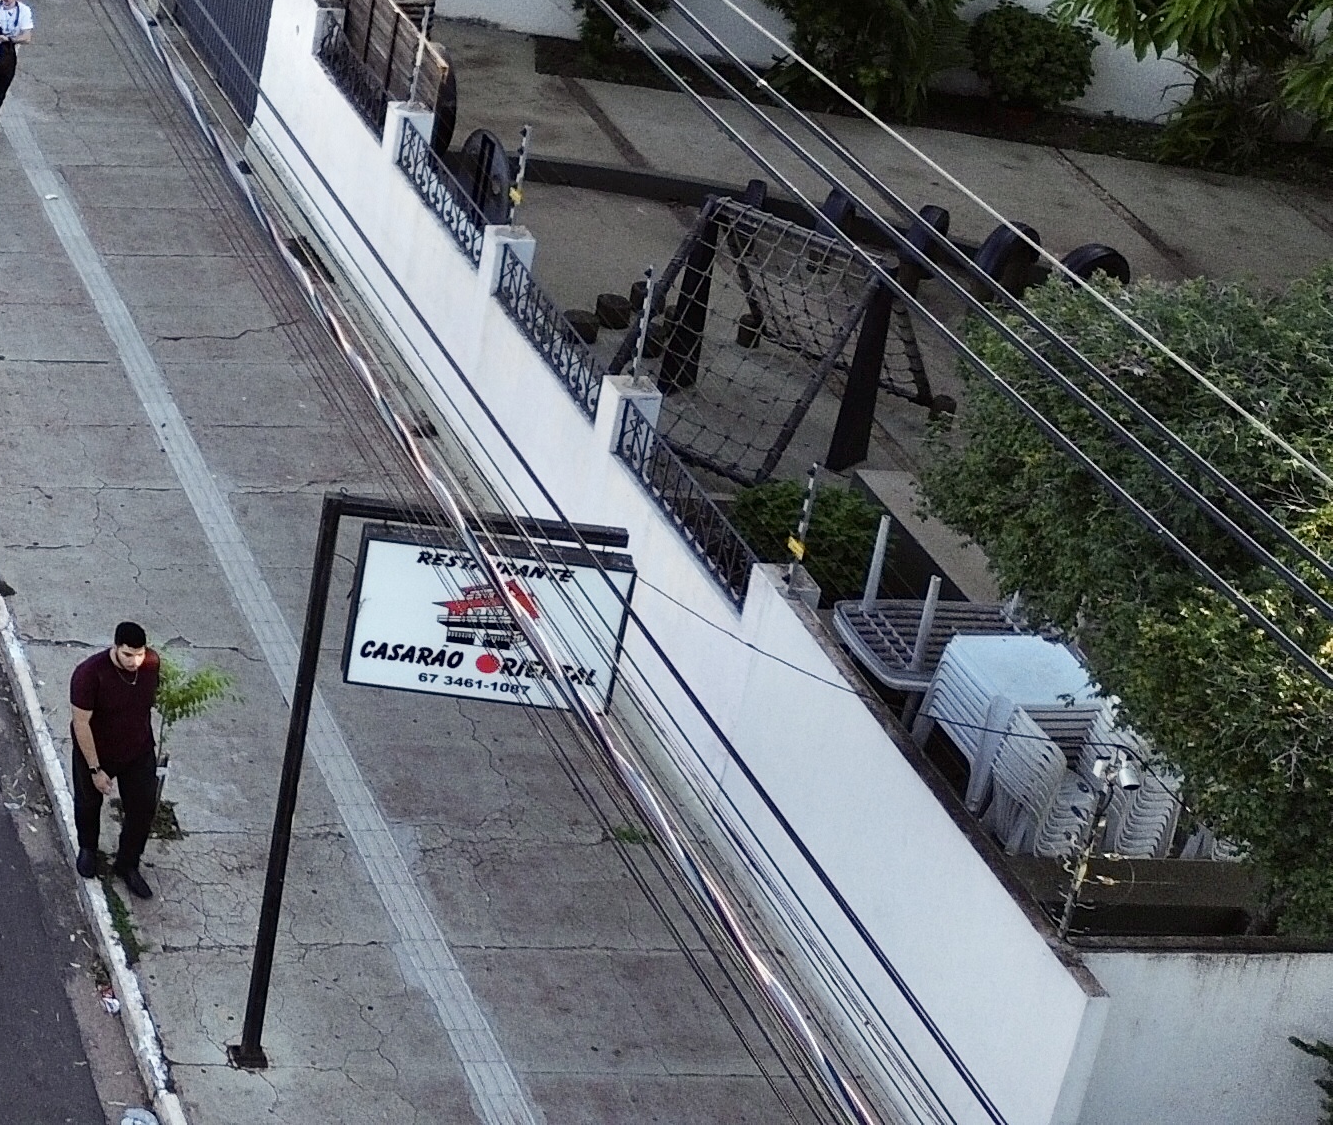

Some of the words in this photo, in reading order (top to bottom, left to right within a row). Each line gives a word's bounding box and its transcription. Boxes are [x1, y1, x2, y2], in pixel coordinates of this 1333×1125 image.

[416, 550, 576, 583] RESTRANTE
[359, 639, 465, 669] CASARÃO
[418, 671, 439, 684] 67
[443, 674, 532, 695] 3461-1087
